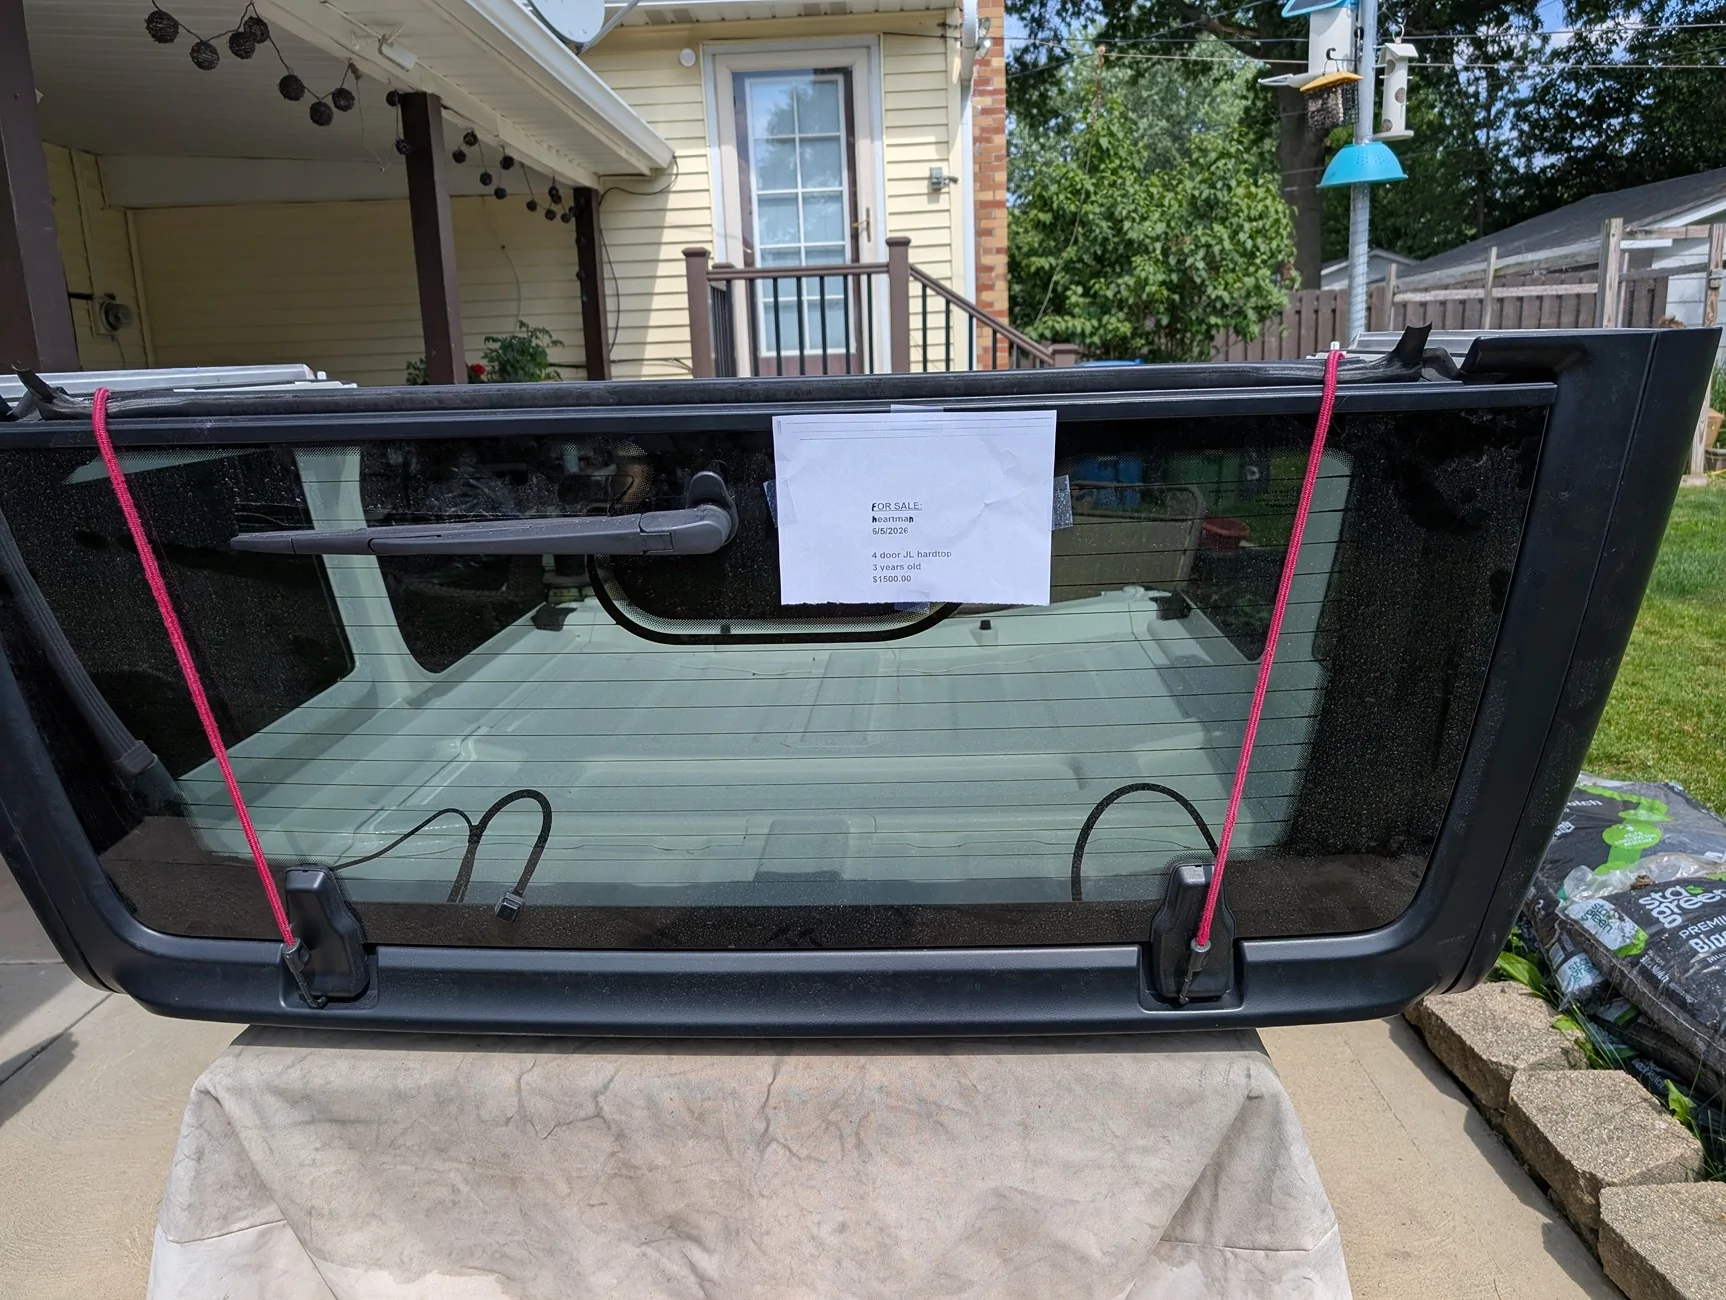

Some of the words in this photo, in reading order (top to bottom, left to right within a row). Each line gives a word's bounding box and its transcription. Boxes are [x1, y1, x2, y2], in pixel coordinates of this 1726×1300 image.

[871, 502, 892, 511] FOR
[894, 502, 923, 511] SALE:
[872, 527, 909, 535] 6/5/2026
[879, 551, 901, 559] door
[917, 550, 952, 559] hardtop
[880, 564, 904, 572] years
[872, 575, 912, 583] $1500.00
